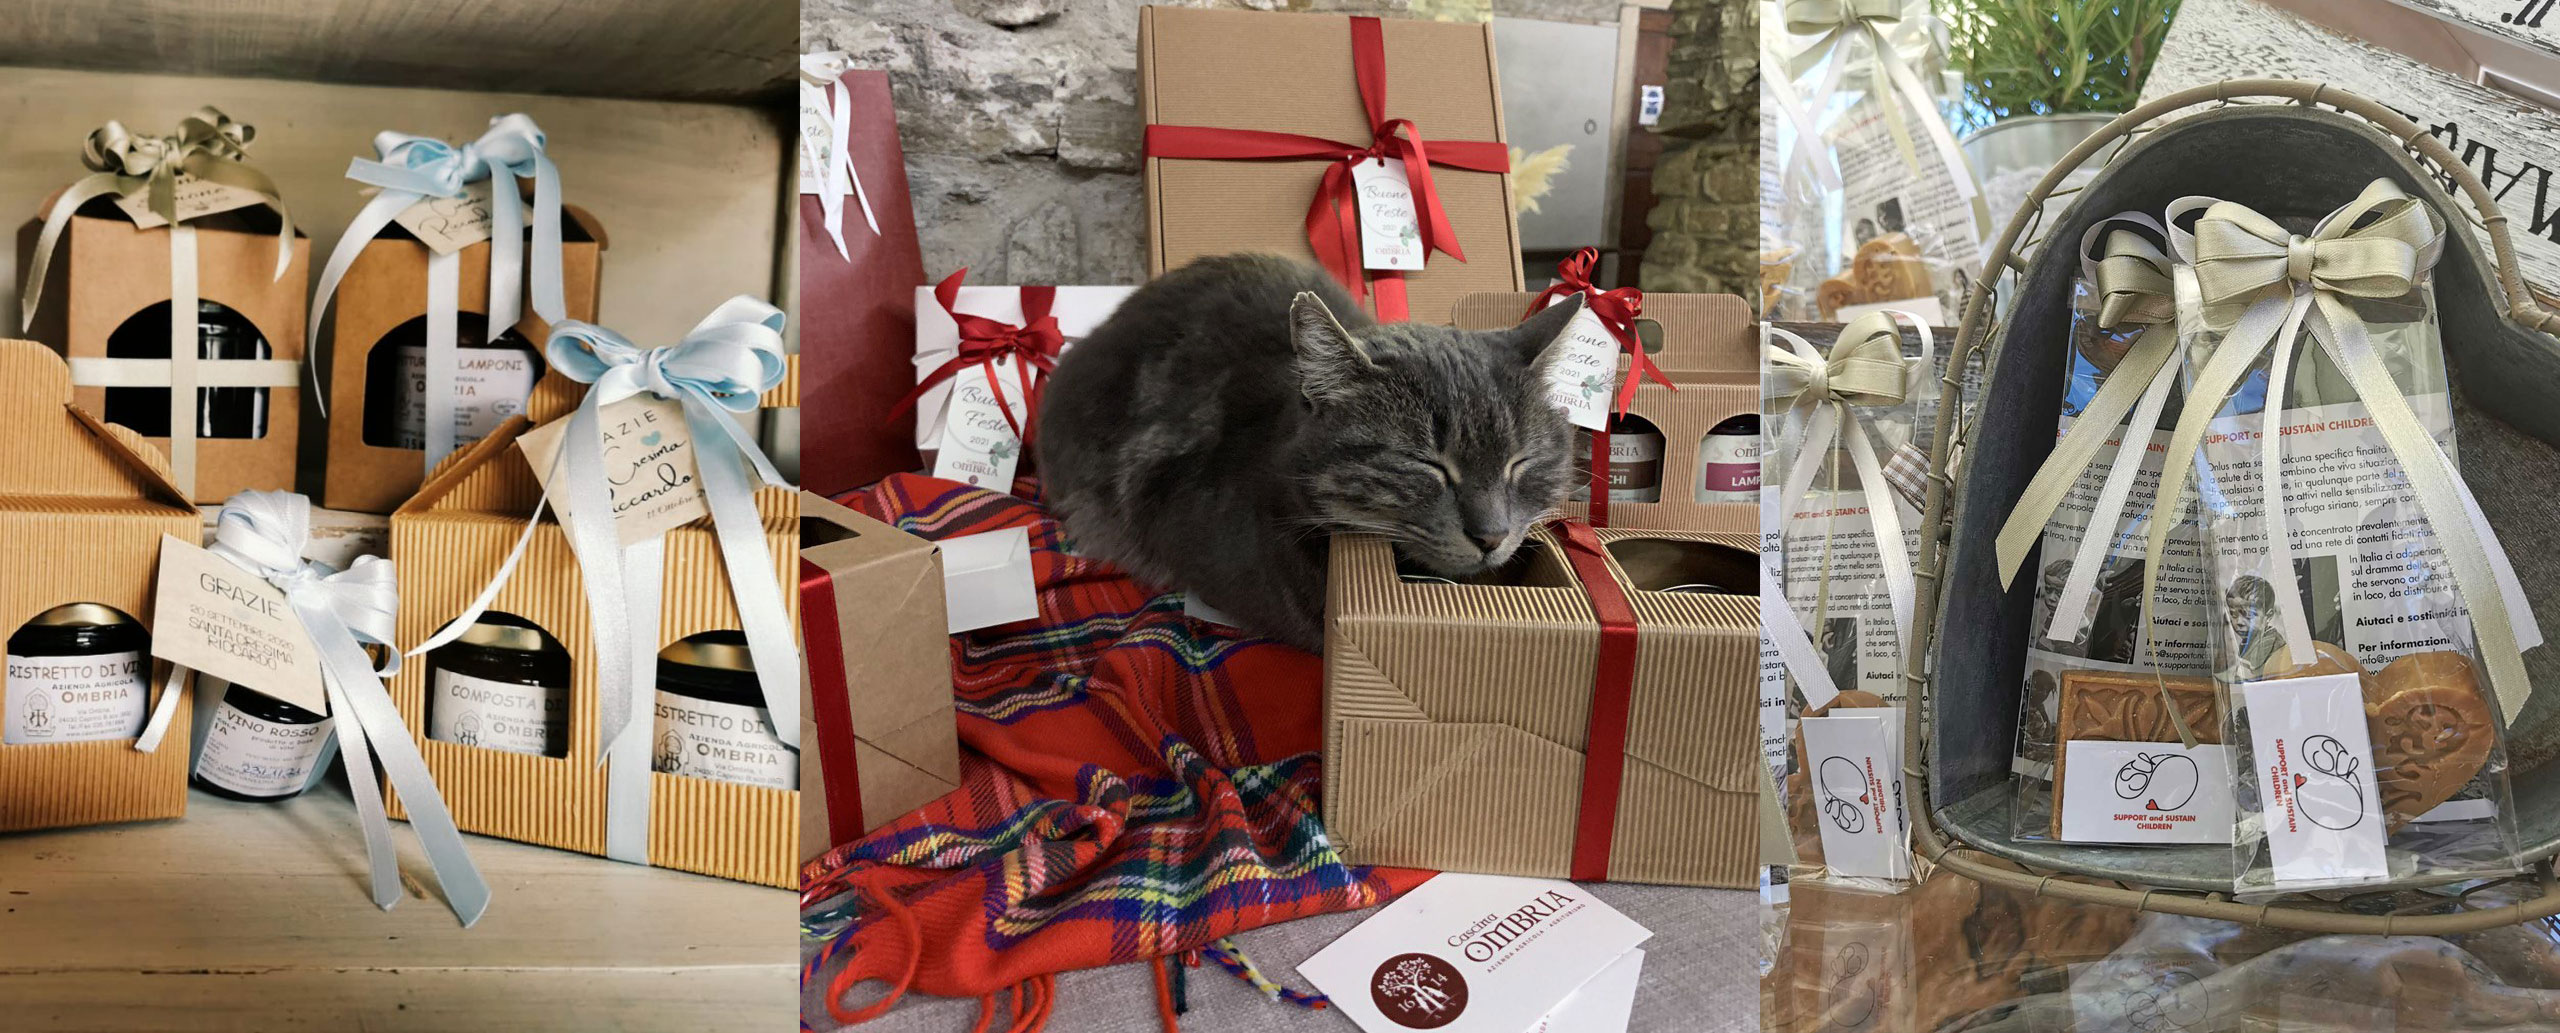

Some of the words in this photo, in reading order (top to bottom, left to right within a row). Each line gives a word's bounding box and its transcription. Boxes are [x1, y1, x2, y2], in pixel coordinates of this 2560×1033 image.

[1363, 185, 1408, 199] Buone
[1372, 203, 1408, 218] Feste
[458, 359, 524, 371] LAMPONI
[1566, 353, 1601, 368] este
[1559, 368, 1580, 379] 2021
[965, 410, 1010, 434] Feste
[2232, 460, 2251, 469] nata
[2282, 454, 2312, 464] alcuna
[2315, 447, 2354, 462] specifica
[2356, 443, 2387, 454] finalità
[2218, 472, 2241, 483] salute
[2243, 470, 2252, 479] di
[2319, 463, 2335, 473] che
[2337, 462, 2356, 470] viva
[2220, 484, 2255, 496] qualsiasi
[2294, 480, 2303, 488] in
[2305, 475, 2354, 489] qualunque
[2356, 473, 2380, 484] parte
[2383, 468, 2396, 479] del
[2296, 489, 2318, 501] attivi
[2321, 488, 2343, 498] nella
[2289, 503, 2325, 516] profuga
[2327, 500, 2362, 510] siriana,
[2364, 496, 2397, 507] sempre
[2292, 528, 2298, 538] è
[2300, 526, 2352, 537] concentrato
[2355, 516, 2428, 533] prevalentemente
[2222, 548, 2241, 557] Iraq,
[2290, 540, 2303, 550] ad
[2305, 541, 2323, 549] una
[2325, 539, 2343, 548] rete
[2345, 535, 2354, 545] di
[2356, 531, 2389, 545] contatti
[2349, 555, 2358, 563] In
[2360, 551, 2383, 562] Italia
[2385, 551, 2393, 560] ci
[2166, 562, 2185, 573] Italia
[2351, 566, 2363, 577] sul
[2365, 563, 2404, 574] dramma
[2351, 579, 2368, 589] che
[2370, 577, 2406, 587] servono
[2408, 574, 2420, 583] ad
[200, 573, 283, 622] GRAZIE
[2162, 595, 2180, 605] loco,
[2353, 592, 2362, 601] in
[2364, 589, 2387, 601] loco,
[2388, 586, 2401, 598] da
[190, 604, 205, 617] 20
[207, 611, 264, 638] SETTEMBRE
[268, 633, 295, 651] 2020
[2355, 614, 2394, 627] Aiutaci
[189, 616, 233, 641] SANTA
[235, 632, 294, 665] CRESIMA
[1865, 627, 1874, 636] sul
[1865, 638, 1877, 647] che
[2358, 643, 2377, 653] Per
[208, 636, 277, 671] RICCARDO
[9, 664, 92, 679] RISTRETTO
[100, 663, 117, 678] DI
[62, 688, 128, 703] OMBRIA
[451, 685, 537, 710] COMPOSTA
[227, 710, 265, 733] VINO
[270, 726, 319, 738] ROSSO
[689, 733, 732, 746] AZIENDA
[696, 743, 778, 765] OMBRIA
[2276, 738, 2289, 777] SUPPORT
[1865, 756, 1875, 786] SUSTAIN
[1876, 778, 1886, 812] CHILDREN
[2270, 765, 2283, 807] CHILDREN
[1873, 803, 1883, 834] SUPPORT
[2113, 813, 2147, 821] SUPPORT
[2285, 797, 2297, 833] SUSTAIN
[1447, 912, 1498, 948] Cascina
[1464, 889, 1575, 963] OMBRIA
[1487, 951, 1514, 973] AZIENDA
[1515, 930, 1544, 953] AGRICOLA
[1430, 973, 1448, 986] 14
[1397, 999, 1416, 1013] 16
